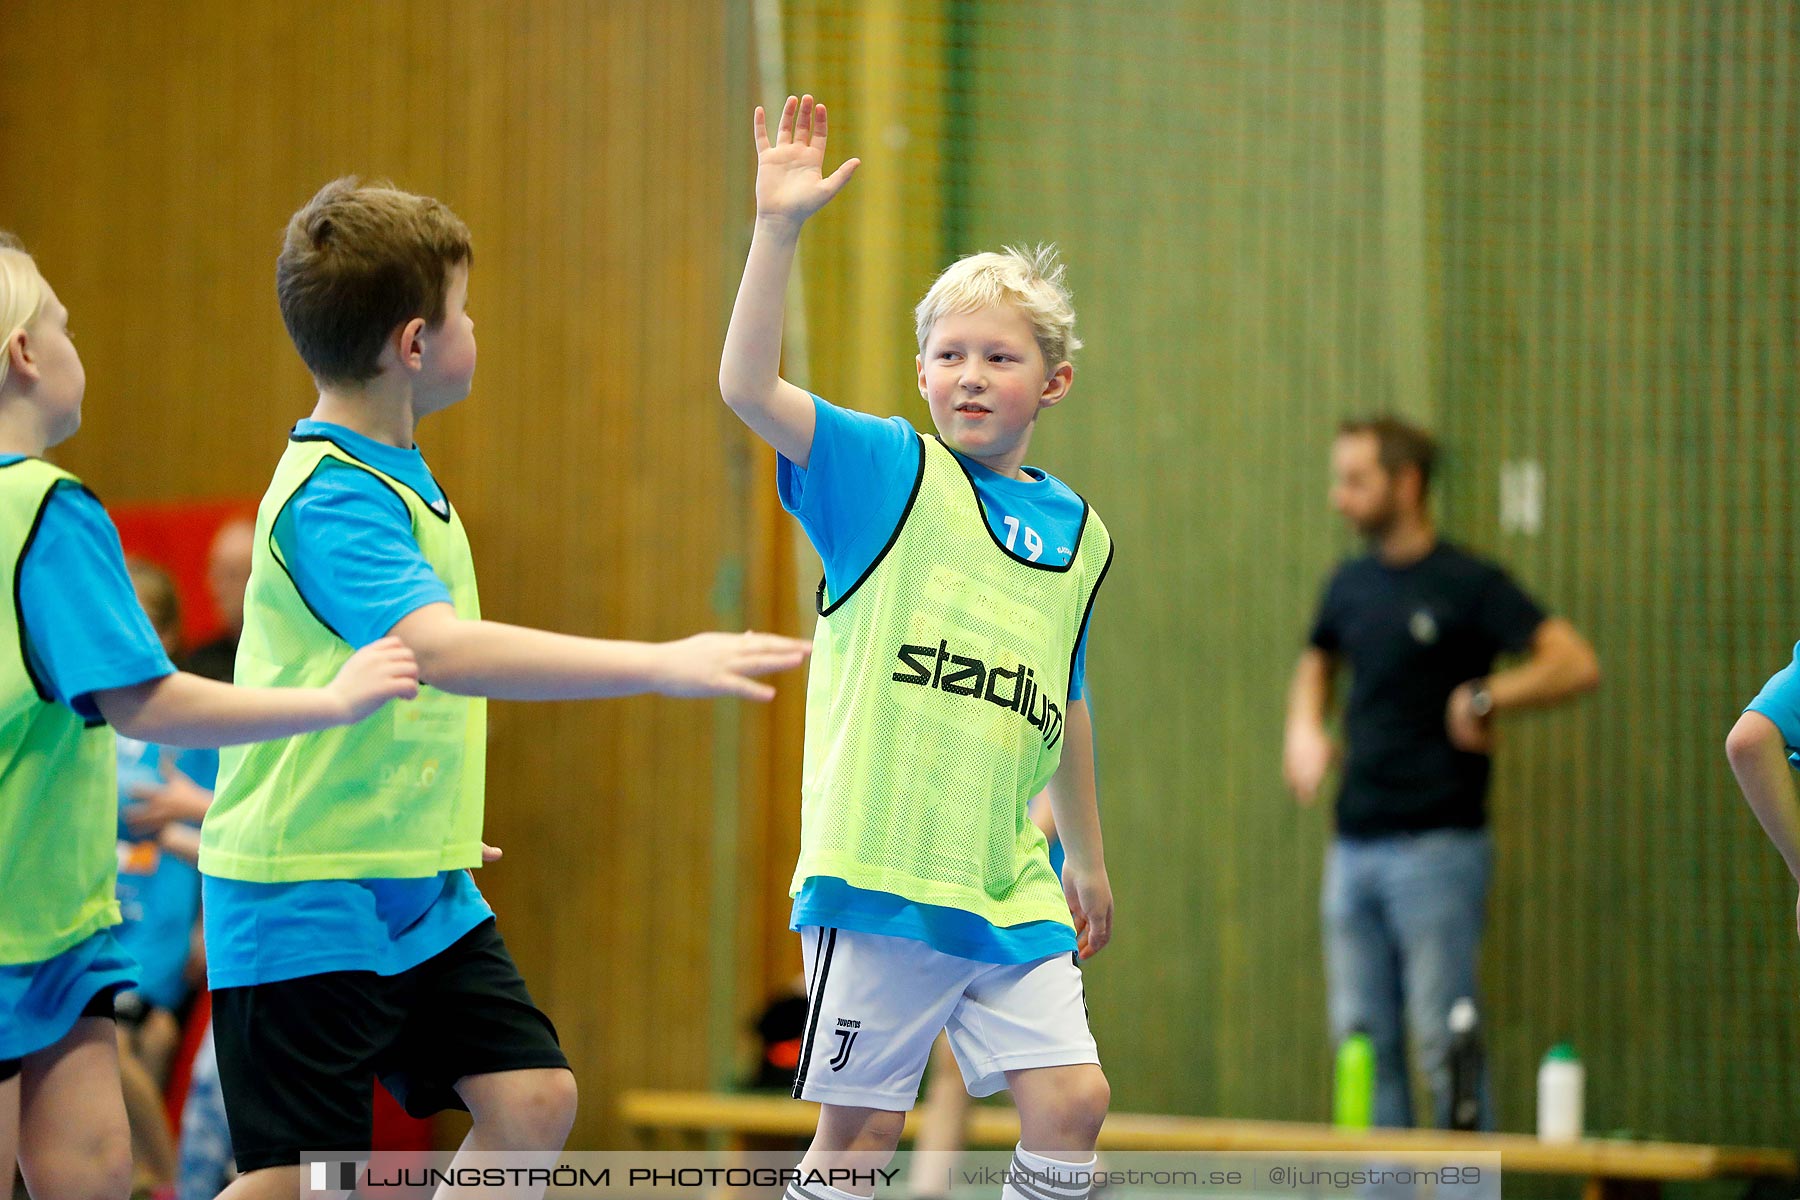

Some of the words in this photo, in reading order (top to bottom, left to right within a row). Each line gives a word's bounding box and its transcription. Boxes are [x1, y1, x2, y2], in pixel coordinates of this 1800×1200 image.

[1003, 515, 1043, 562] 19
[891, 638, 1063, 751] stadium
[836, 1017, 861, 1028] JUVENTUS
